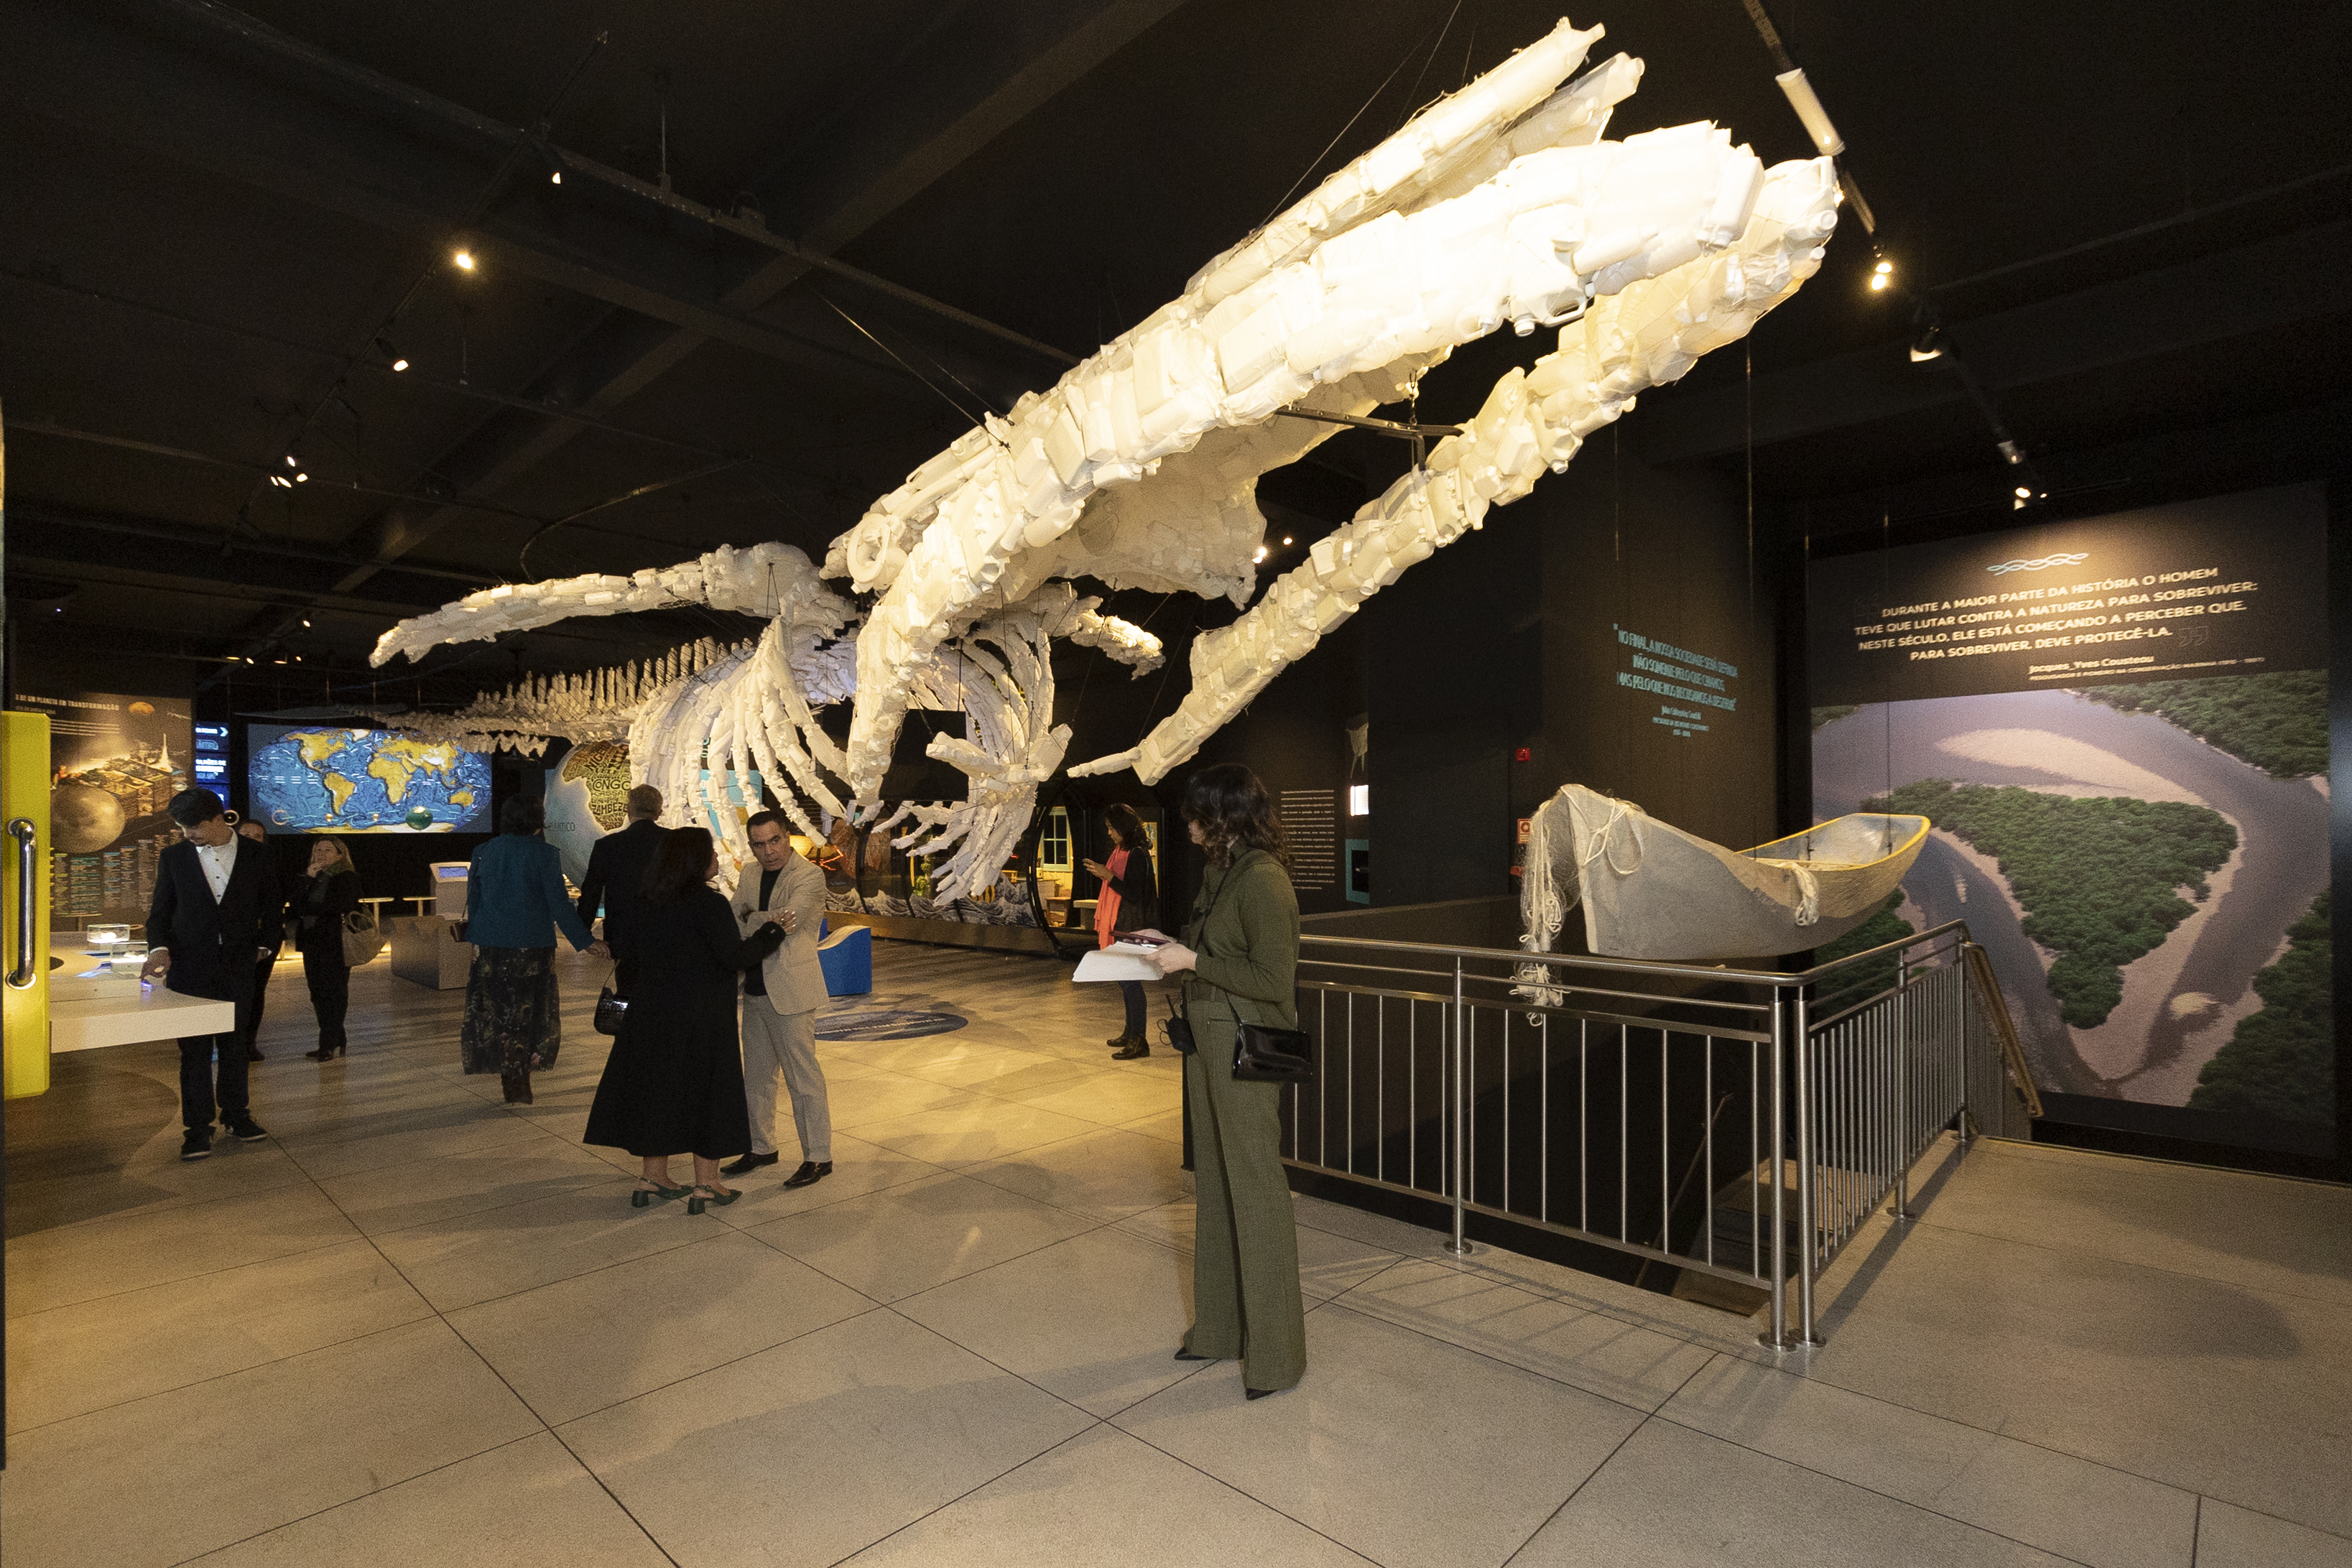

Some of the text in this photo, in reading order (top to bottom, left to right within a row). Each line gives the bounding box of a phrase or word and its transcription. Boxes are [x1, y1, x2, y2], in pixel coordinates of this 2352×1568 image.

[1881, 567, 2219, 618] DURANTE A MAIOR PARTE DA HISTÓRIA O HOMEM
[1854, 623, 1884, 636] TEVE
[1886, 621, 1912, 633] QUE
[1913, 616, 1956, 630] LUTAR
[1957, 609, 2014, 625] CONTRA
[2016, 608, 2027, 618] A
[2029, 598, 2105, 616] NATUREZA
[2107, 593, 2151, 607] PARA
[1858, 638, 1896, 651] NESTE
[1952, 629, 1976, 641] ELE
[1978, 623, 2013, 639] ESTÁ
[2014, 615, 2108, 634] COMEÇANDO
[2109, 614, 2123, 625] A
[2124, 604, 2205, 623] PERCEBER
[1909, 648, 1946, 662] PARA
[2034, 636, 2072, 649] DEVE
[2100, 656, 2154, 667] Cousteau
[1619, 672, 1633, 687] MAS
[1633, 674, 1650, 691] PELO
